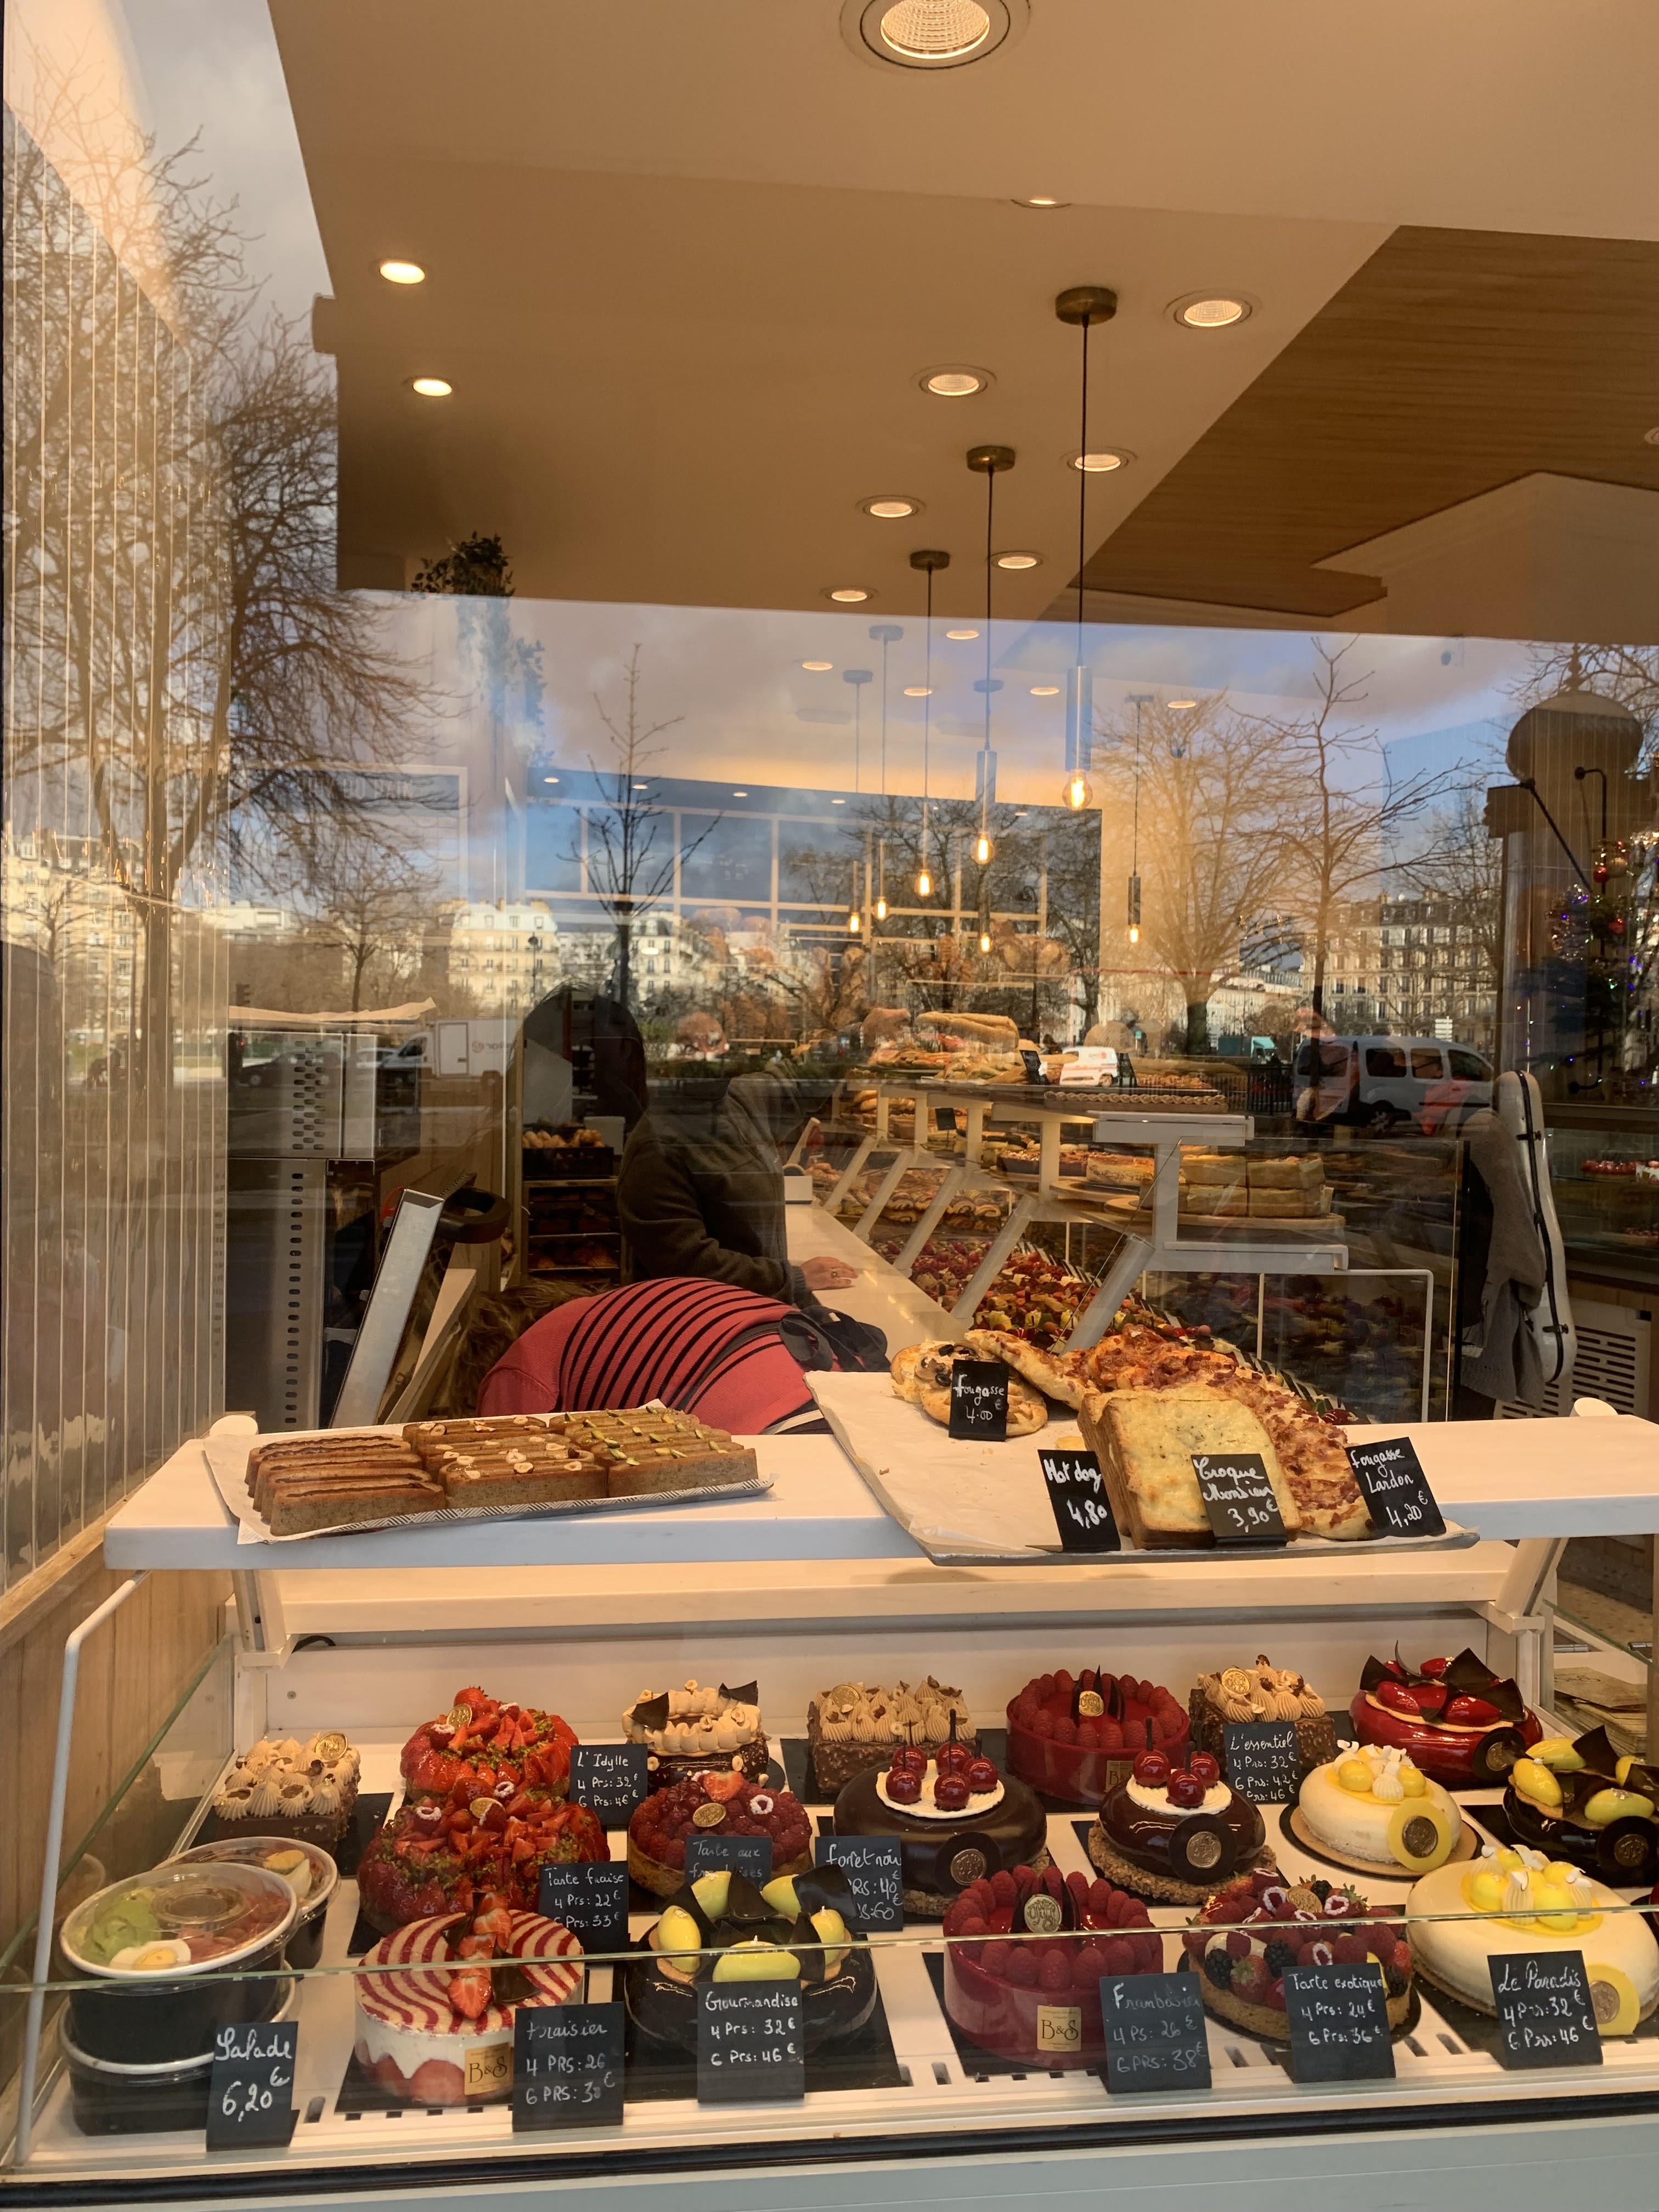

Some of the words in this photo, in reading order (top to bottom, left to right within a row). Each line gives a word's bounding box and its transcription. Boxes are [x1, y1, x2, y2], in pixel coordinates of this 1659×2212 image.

[1043, 1459, 1070, 1483] Hot
[1074, 1460, 1102, 1494] dog
[1193, 1456, 1264, 1486] Croque
[1365, 1470, 1414, 1494] Lardon
[1066, 1499, 1107, 1528] 4,80
[1233, 1758, 1242, 1770] 4
[578, 1779, 586, 1791] 4
[1235, 1777, 1244, 1790] 6
[738, 1849, 760, 1858] aux
[543, 1867, 579, 1886] Tarte
[555, 1898, 563, 1909] 4
[1288, 1973, 1329, 1990] Tarte
[1334, 1974, 1383, 1994] exotique
[1498, 1963, 1522, 1993] Le
[1525, 1960, 1581, 1989] Paradis
[705, 1991, 798, 2011] Gourmandise
[1301, 2006, 1313, 2021] 4
[1504, 2006, 1516, 2028] 4
[711, 2025, 721, 2040] 4
[1113, 2027, 1125, 2045] 4
[1308, 2030, 1321, 2045] 6
[215, 2027, 292, 2061] Salade
[527, 2058, 537, 2076] 4
[1117, 2057, 1131, 2073] 6
[526, 2088, 538, 2104] 6
